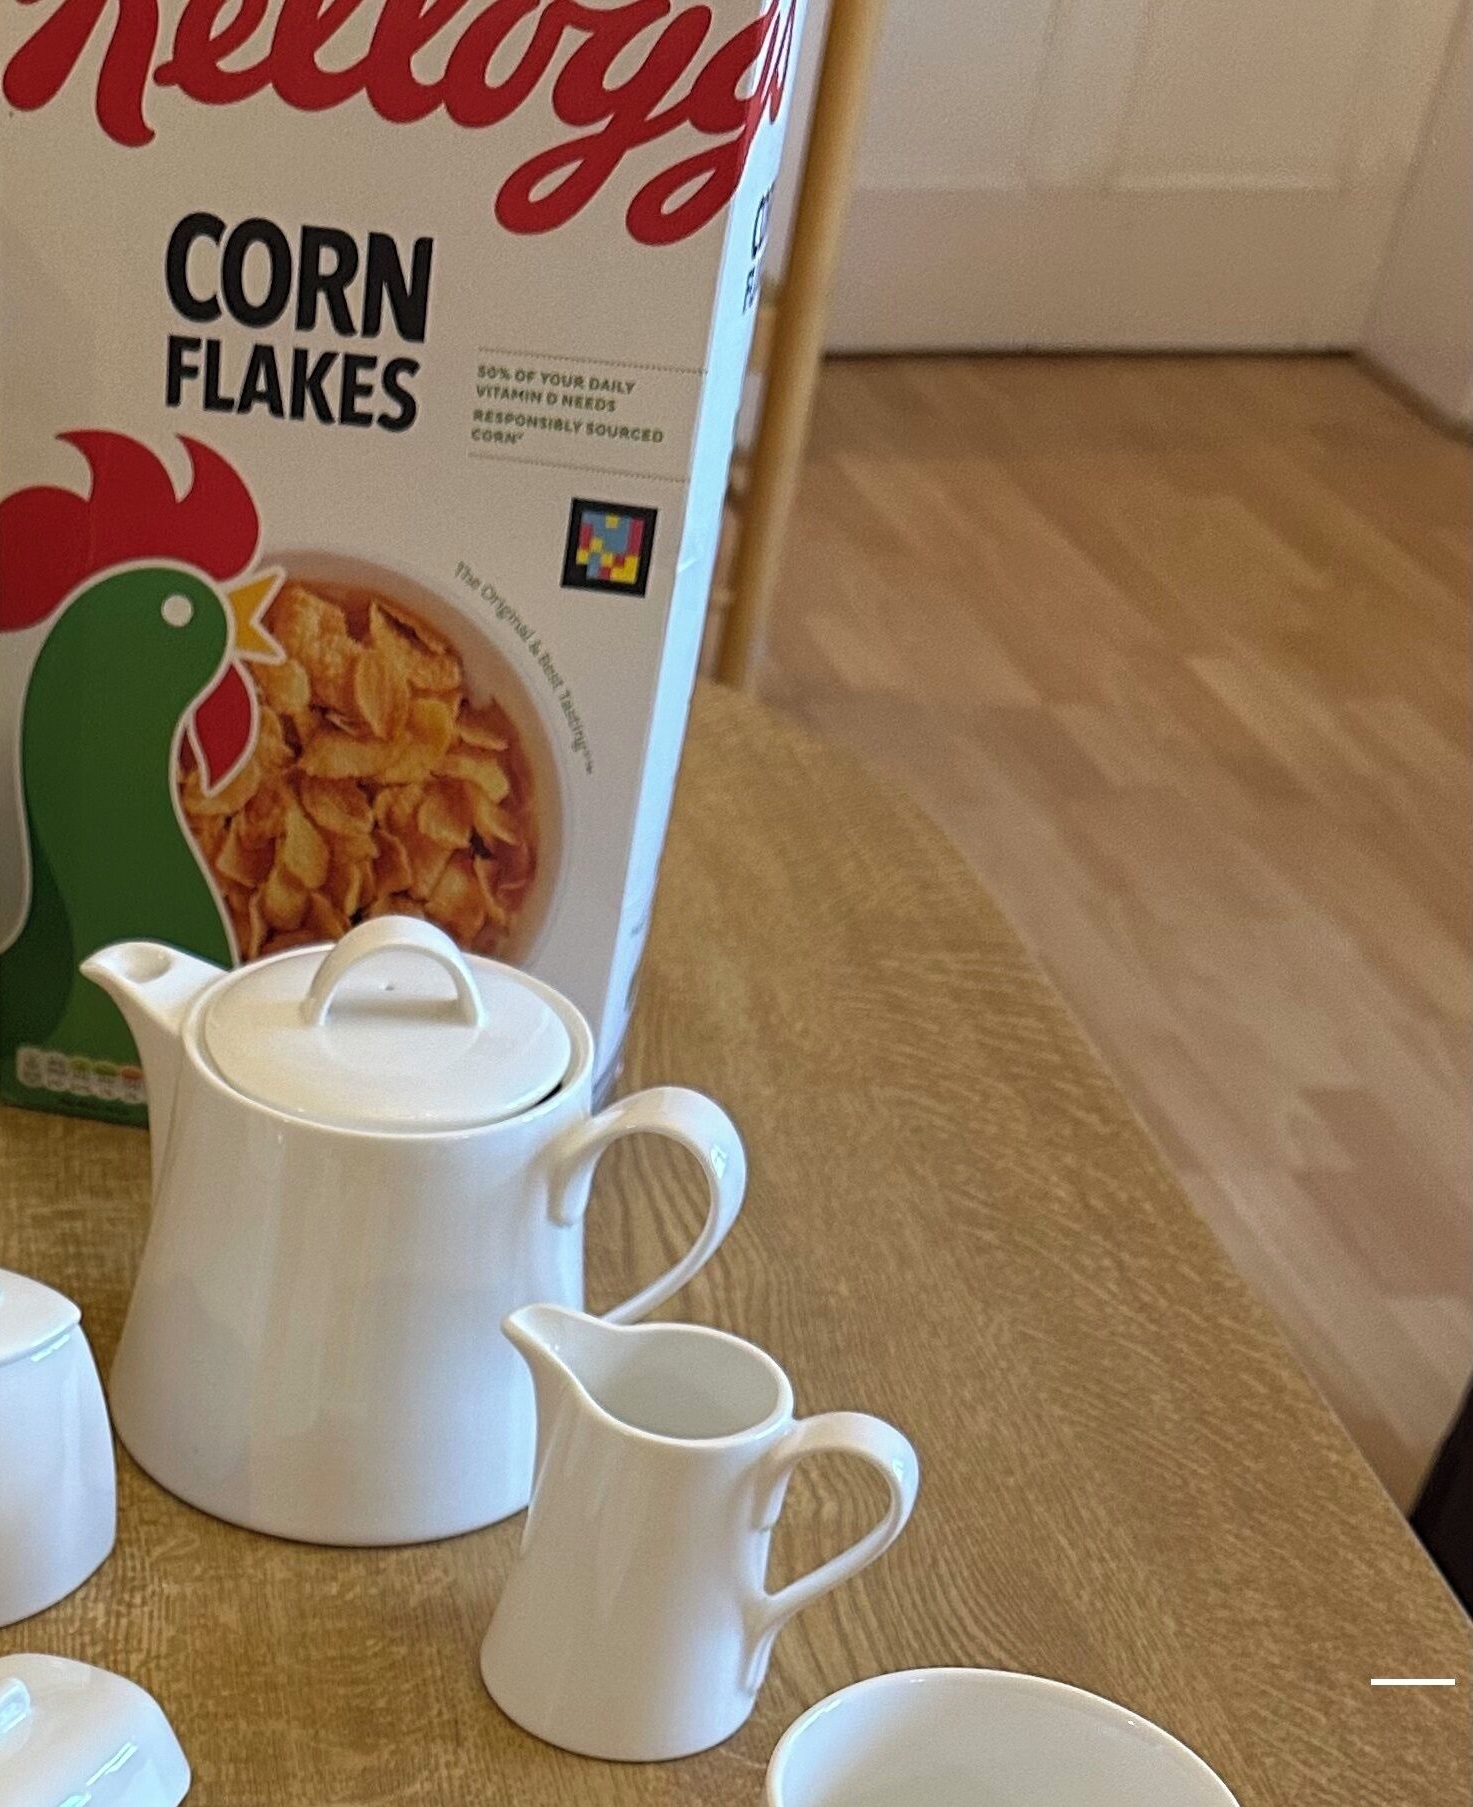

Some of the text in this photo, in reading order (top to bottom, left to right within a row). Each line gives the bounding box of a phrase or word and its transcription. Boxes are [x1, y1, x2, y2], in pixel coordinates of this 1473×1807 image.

[165, 212, 434, 343] CORN
[165, 335, 421, 432] FLAKES
[476, 386, 616, 412] VITAMIN D NEEDS
[477, 365, 635, 394] 50% OF YOUR DAILY
[473, 409, 663, 443] RESPONSIBLY SOURCED
[454, 560, 480, 591] The
[481, 584, 537, 643] Original
[538, 652, 564, 690] Best
